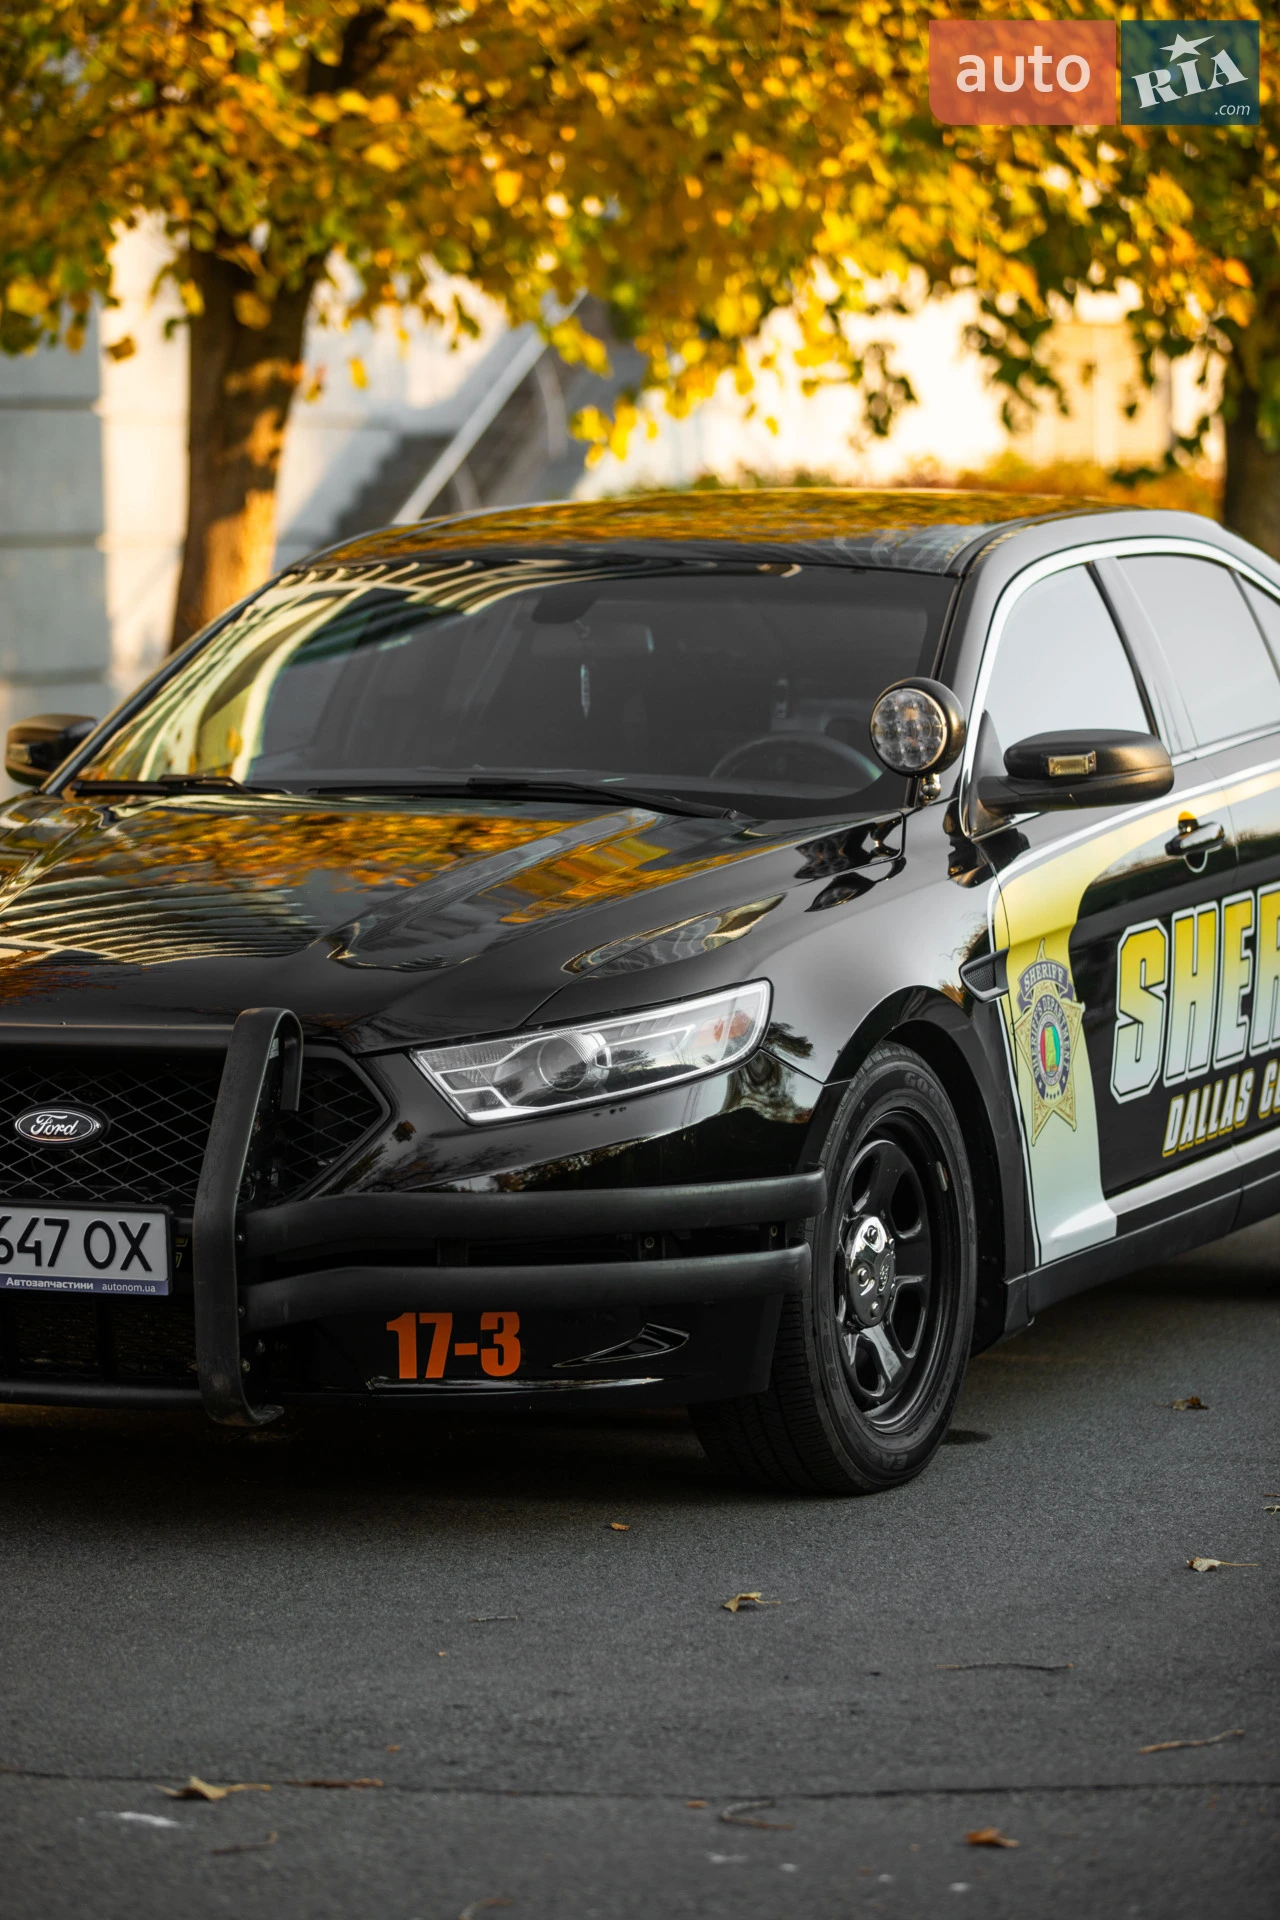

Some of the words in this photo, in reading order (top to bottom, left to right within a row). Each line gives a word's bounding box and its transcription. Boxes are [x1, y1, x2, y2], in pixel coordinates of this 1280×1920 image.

[1023, 962, 1064, 992] SHERIFF
[30, 1114, 80, 1136] Ford
[1162, 1069, 1255, 1158] DALLAS
[83, 1220, 153, 1272] OX
[6, 1277, 94, 1290] Автозапчастини
[102, 1282, 156, 1293] autonom.ua
[386, 1311, 522, 1379] 17-3
